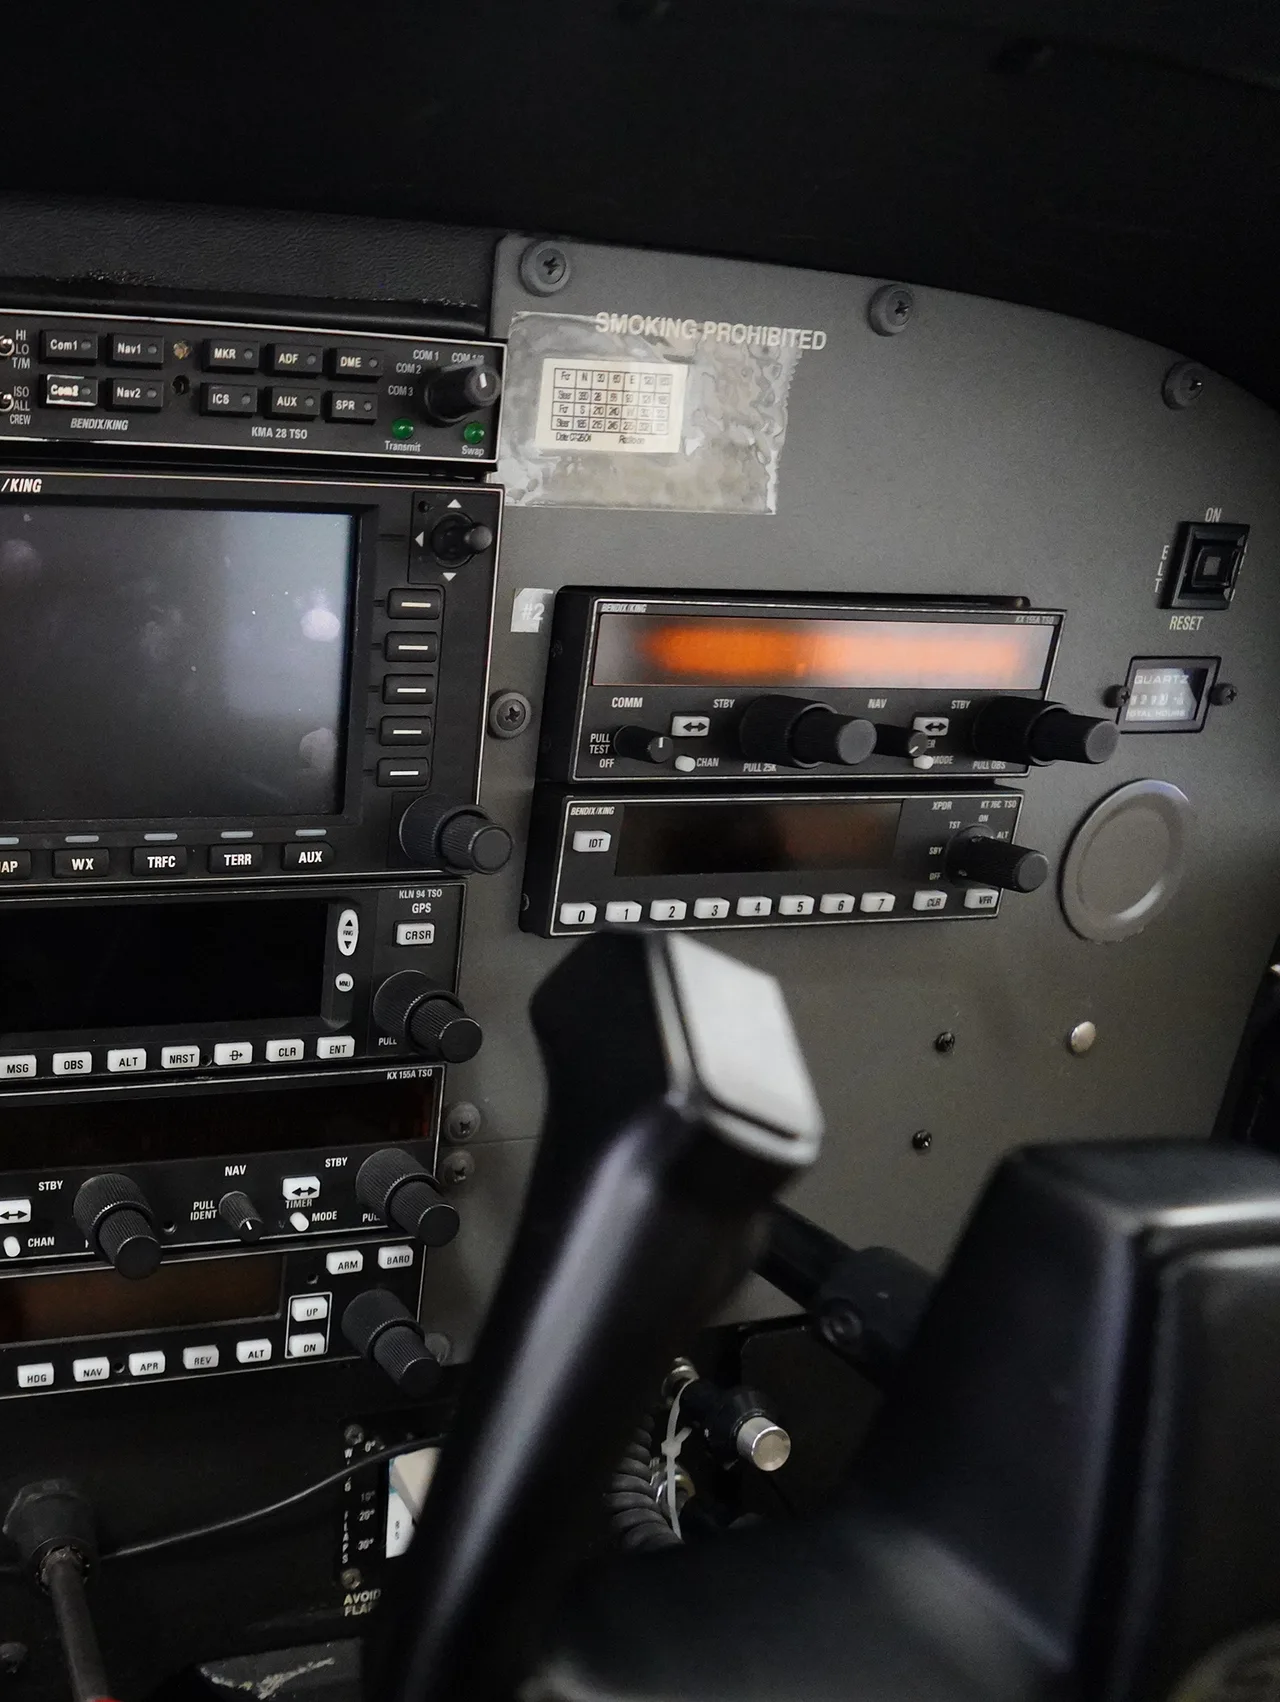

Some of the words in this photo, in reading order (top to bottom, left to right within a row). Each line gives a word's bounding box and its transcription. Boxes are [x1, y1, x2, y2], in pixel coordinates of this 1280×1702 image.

[15, 329, 27, 340] HI
[595, 311, 698, 340] SMOKING
[702, 320, 827, 351] PROHIBITED
[50, 340, 78, 351] Com1
[117, 343, 141, 354] Nav1
[214, 348, 236, 359] MKR
[278, 353, 299, 364] ADF
[413, 350, 432, 360] COM
[434, 351, 439, 361] 1
[12, 357, 30, 369] T/M
[340, 356, 361, 368] DME
[396, 363, 414, 373] COM
[415, 364, 421, 374] 2
[13, 386, 29, 397] ISO
[117, 387, 141, 398] Nav2
[388, 385, 406, 396] COM
[407, 386, 414, 396] 3
[212, 394, 229, 404] ICS
[276, 397, 298, 407] AUX
[336, 400, 355, 411] SPR
[9, 414, 31, 425] CREW
[70, 418, 128, 431] BENDIX/KING
[251, 427, 273, 438] KMA
[275, 428, 287, 438] 28
[289, 429, 308, 439] TSO
[385, 441, 421, 452] Transmit
[462, 445, 484, 456] Swap
[1204, 507, 1222, 523] ON
[522, 603, 544, 620] #2
[1169, 616, 1204, 631] RESET
[612, 697, 643, 709] COMM
[714, 699, 735, 709] STBY
[868, 699, 887, 708] NAV
[590, 734, 610, 743] PULL
[589, 745, 609, 754] TEST
[599, 758, 614, 768] OFF
[932, 801, 952, 810] XPDR
[949, 821, 960, 829] TST
[588, 838, 603, 848] IDT
[147, 856, 176, 869] TRFC
[224, 854, 252, 866] TERR
[299, 851, 323, 863] AUX
[72, 858, 94, 871] WX
[399, 889, 414, 899] KLN
[416, 889, 425, 898] 94
[427, 889, 442, 898] TSO
[412, 903, 431, 914] GPS
[668, 906, 676, 918] 2
[712, 904, 718, 916] 3
[754, 902, 762, 914] 4
[797, 901, 804, 913] 5
[405, 930, 431, 941] CRSR
[278, 1046, 296, 1057] CLR
[329, 1044, 347, 1055] ENT
[64, 1059, 83, 1070] OBS
[119, 1056, 138, 1067] ALT
[169, 1054, 195, 1064] NRST
[7, 1063, 29, 1074] MSG
[387, 1070, 398, 1080] KX
[399, 1070, 416, 1080] 155A
[418, 1069, 432, 1078] TSO
[325, 1157, 348, 1168] STBY
[225, 1165, 246, 1176] NAV
[38, 1180, 63, 1191] STBY
[193, 1200, 215, 1211] PULL
[190, 1209, 217, 1221] IDENT
[311, 1210, 338, 1222] MODE
[28, 1237, 55, 1248] CHAN
[337, 1260, 358, 1270] ARM
[387, 1255, 410, 1265] BARO
[307, 1308, 318, 1317] UP
[248, 1349, 265, 1358] ALT
[194, 1356, 211, 1365] REV
[140, 1362, 158, 1372] APR
[27, 1374, 47, 1383] HDG
[83, 1368, 103, 1378] NAV
